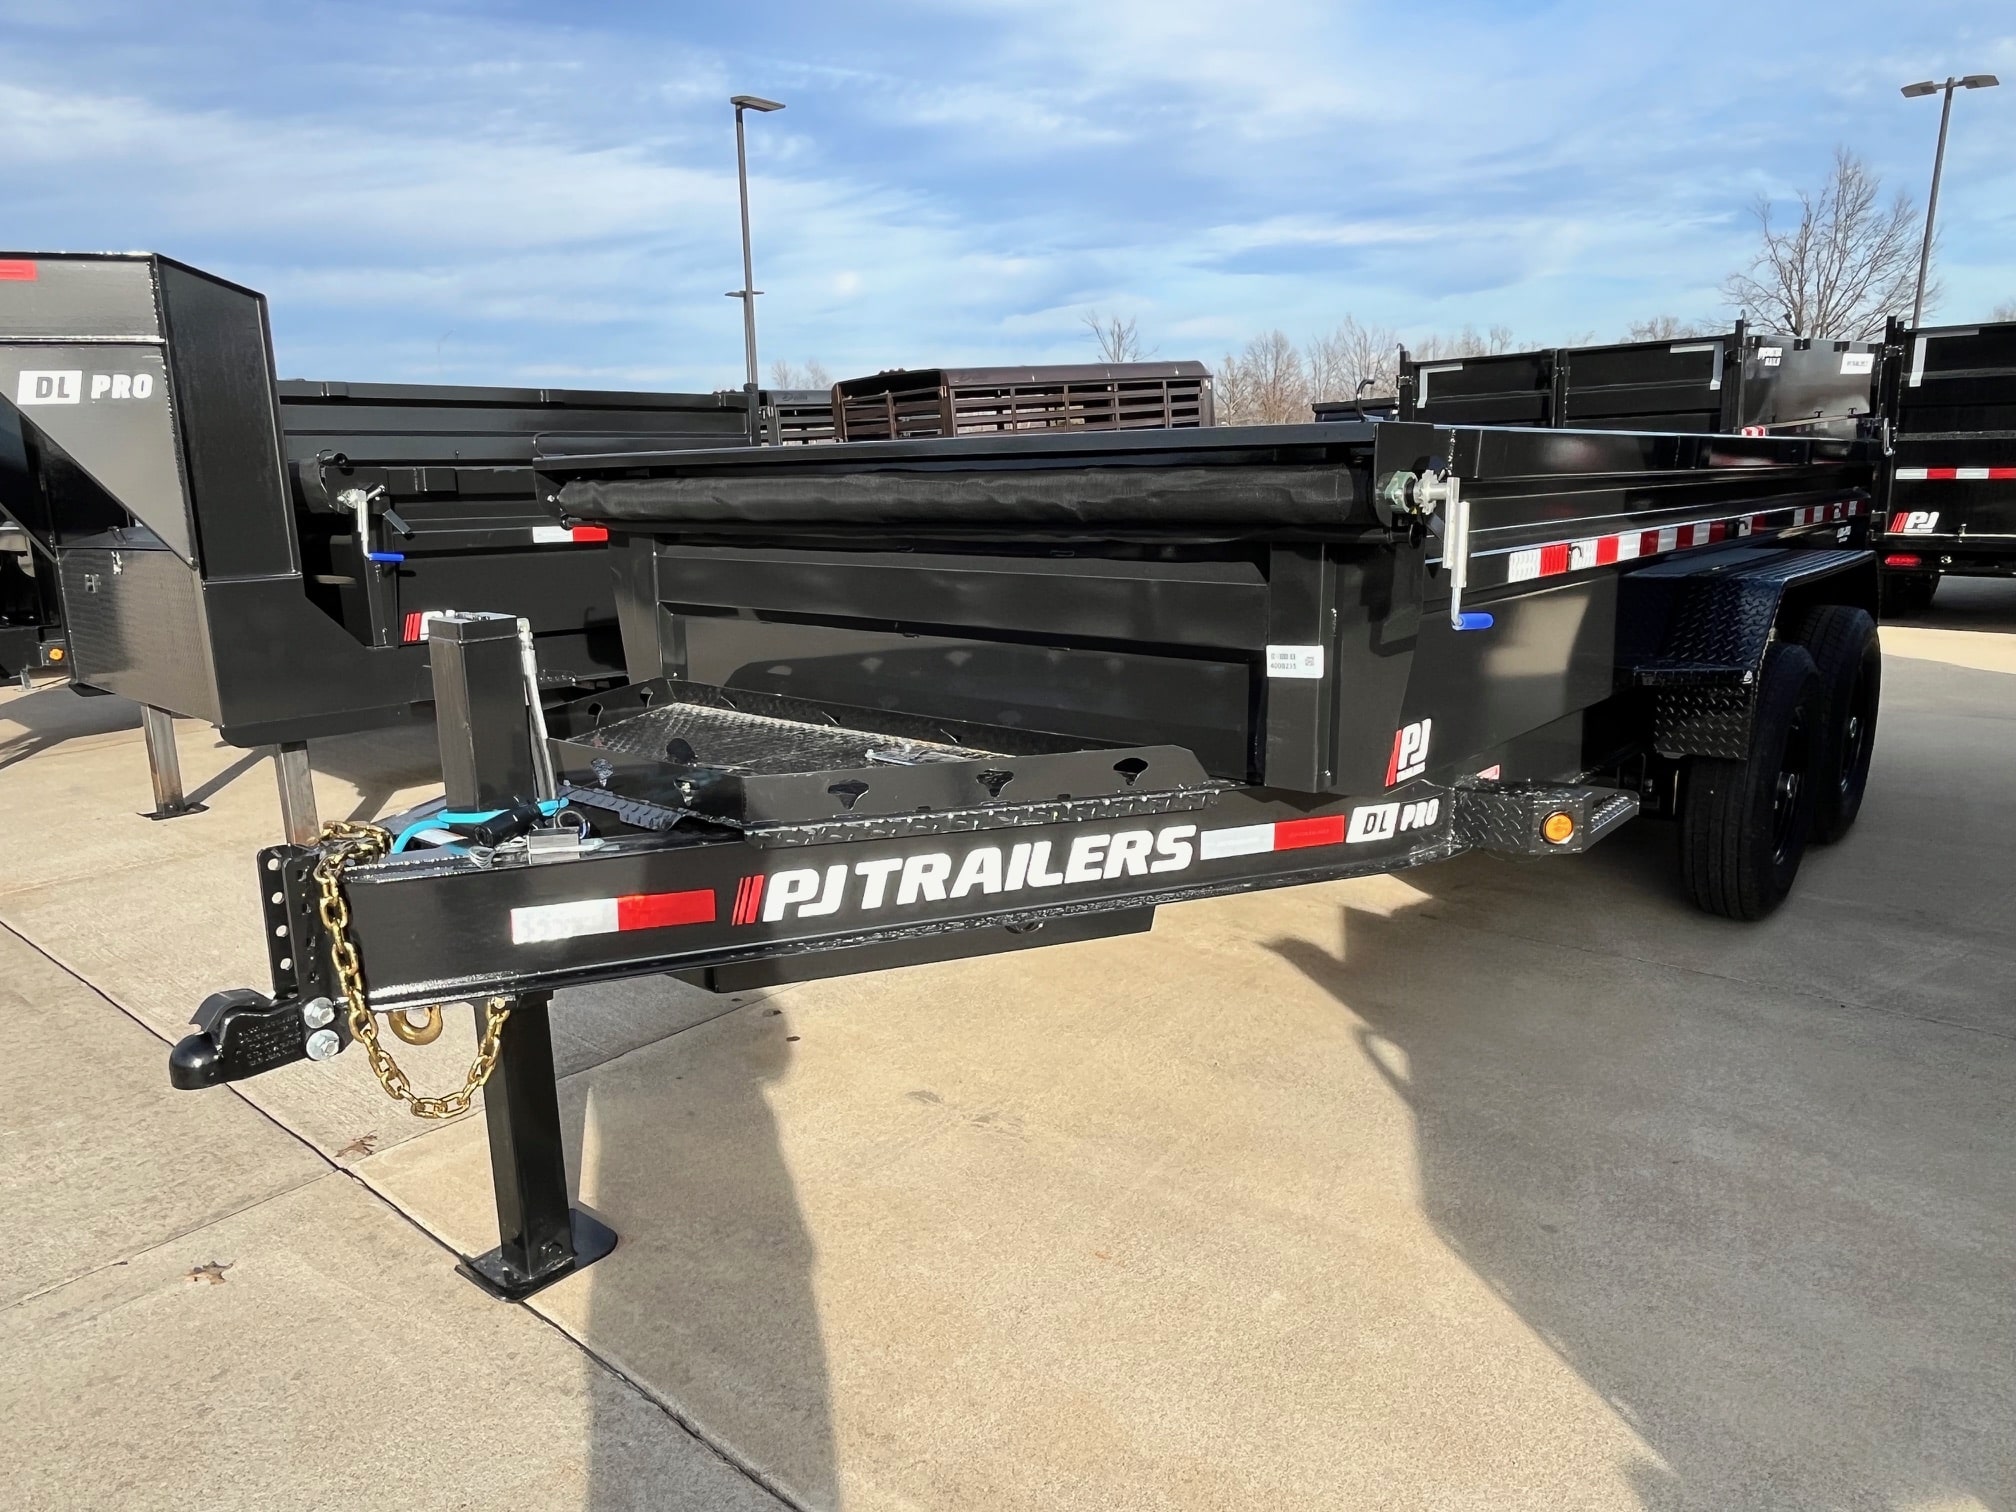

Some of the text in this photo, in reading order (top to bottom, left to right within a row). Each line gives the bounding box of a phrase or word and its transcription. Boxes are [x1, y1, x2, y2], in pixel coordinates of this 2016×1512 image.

[35, 373, 154, 399] DL PRO
[1903, 511, 1940, 529] PJ
[1397, 718, 1432, 771] PJ
[1363, 798, 1440, 835] DL PRO
[762, 824, 1198, 923] PJ TRAILERS
